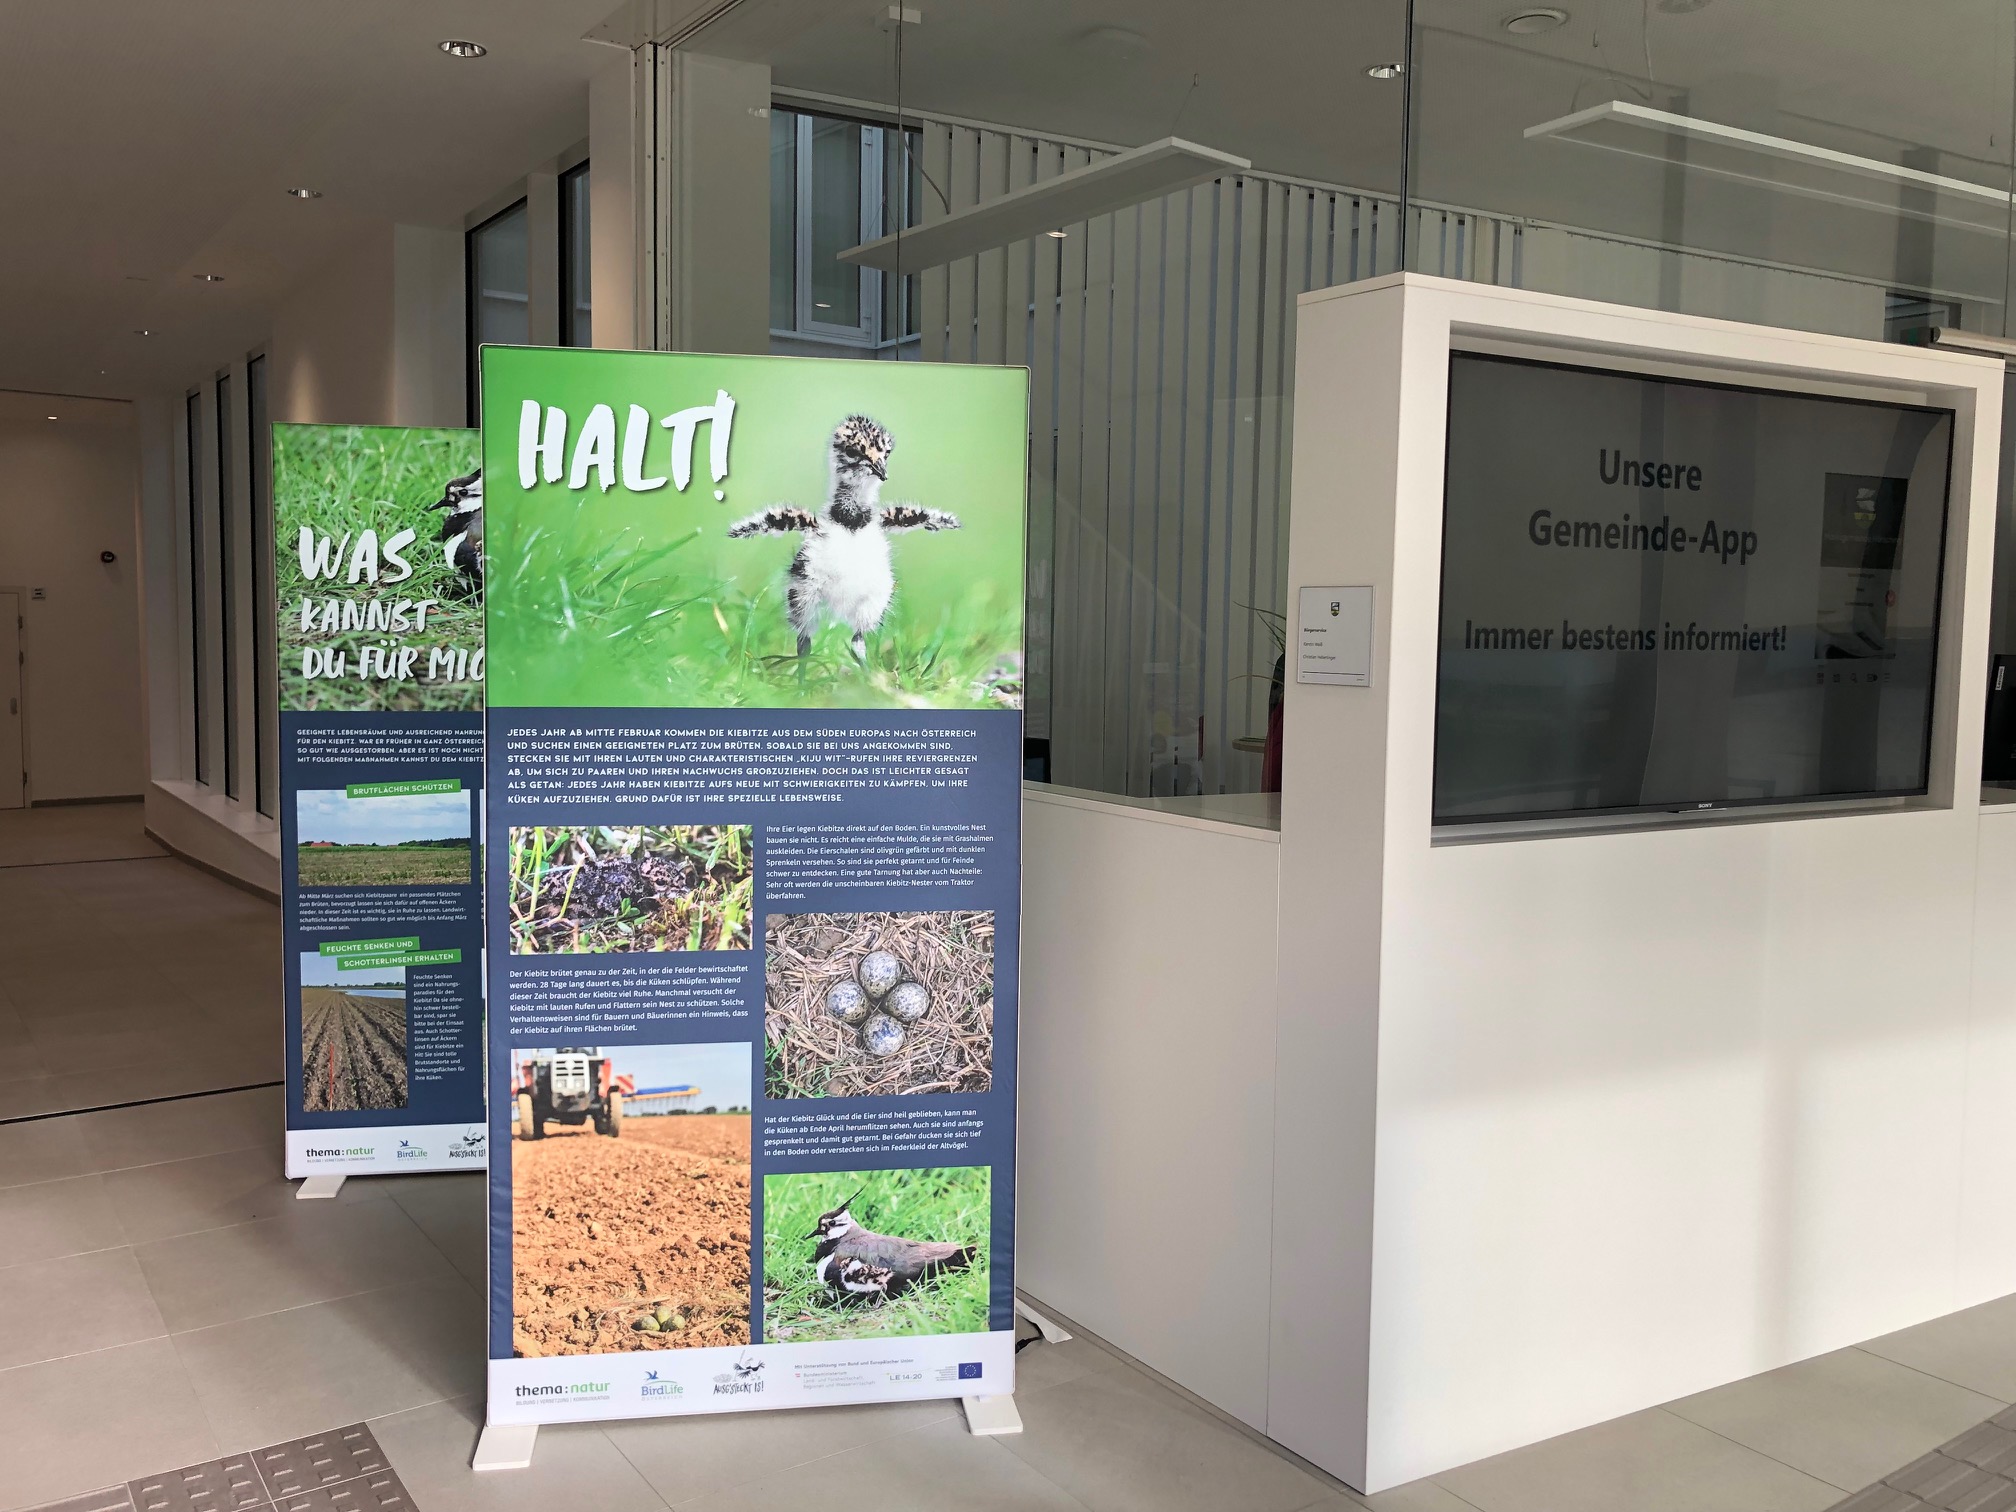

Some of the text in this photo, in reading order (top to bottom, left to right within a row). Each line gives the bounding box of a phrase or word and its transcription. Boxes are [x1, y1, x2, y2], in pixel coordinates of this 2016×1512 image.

[518, 389, 735, 501] HALT!
[1599, 448, 1702, 491] Unsere
[1528, 509, 1758, 565] Gemeinde-App
[299, 525, 416, 585] WAS
[301, 598, 438, 632] KANNST
[1465, 620, 1787, 652] Immer bestens informiert!
[302, 645, 345, 680] DU
[359, 640, 418, 682] FÜR
[507, 728, 537, 736] JEDES
[540, 728, 566, 736] JAHR
[569, 728, 582, 736] AB
[585, 728, 615, 736] MITTE
[618, 728, 661, 736] FEBRUAR
[815, 728, 846, 736] SÜDEN
[893, 729, 918, 737] NACH
[921, 728, 976, 737] ÖSTERREICH
[507, 741, 527, 749] UND
[530, 741, 570, 749] SUCHEN
[573, 741, 601, 749] EINEN
[605, 741, 664, 749] GEEIGNETEN
[668, 741, 697, 749] PLATZ
[700, 741, 721, 749] ZUM
[724, 740, 763, 749] BRÜTEN.
[929, 742, 953, 750] SIND,
[353, 783, 453, 794] BRUTFLÄCHEN SCHÜTZEN
[796, 825, 815, 833] legen
[326, 940, 413, 952] FEUCHTE SENKEN UND
[343, 953, 453, 967] SCHOTTERLINSEN ERHALTEN
[524, 969, 548, 977] Kiebitz
[550, 968, 573, 976] brütet
[621, 967, 637, 975] Zeit,
[661, 966, 673, 974] die
[698, 964, 748, 973] bewirtschaftet
[791, 1114, 814, 1122] Kiebitz
[815, 1113, 835, 1121] Glück
[877, 1111, 892, 1119] sind
[893, 1110, 907, 1118] heil
[908, 1109, 942, 1119] geblieben,
[397, 1150, 427, 1158] BirdLife
[641, 1384, 684, 1396] BirdLife
